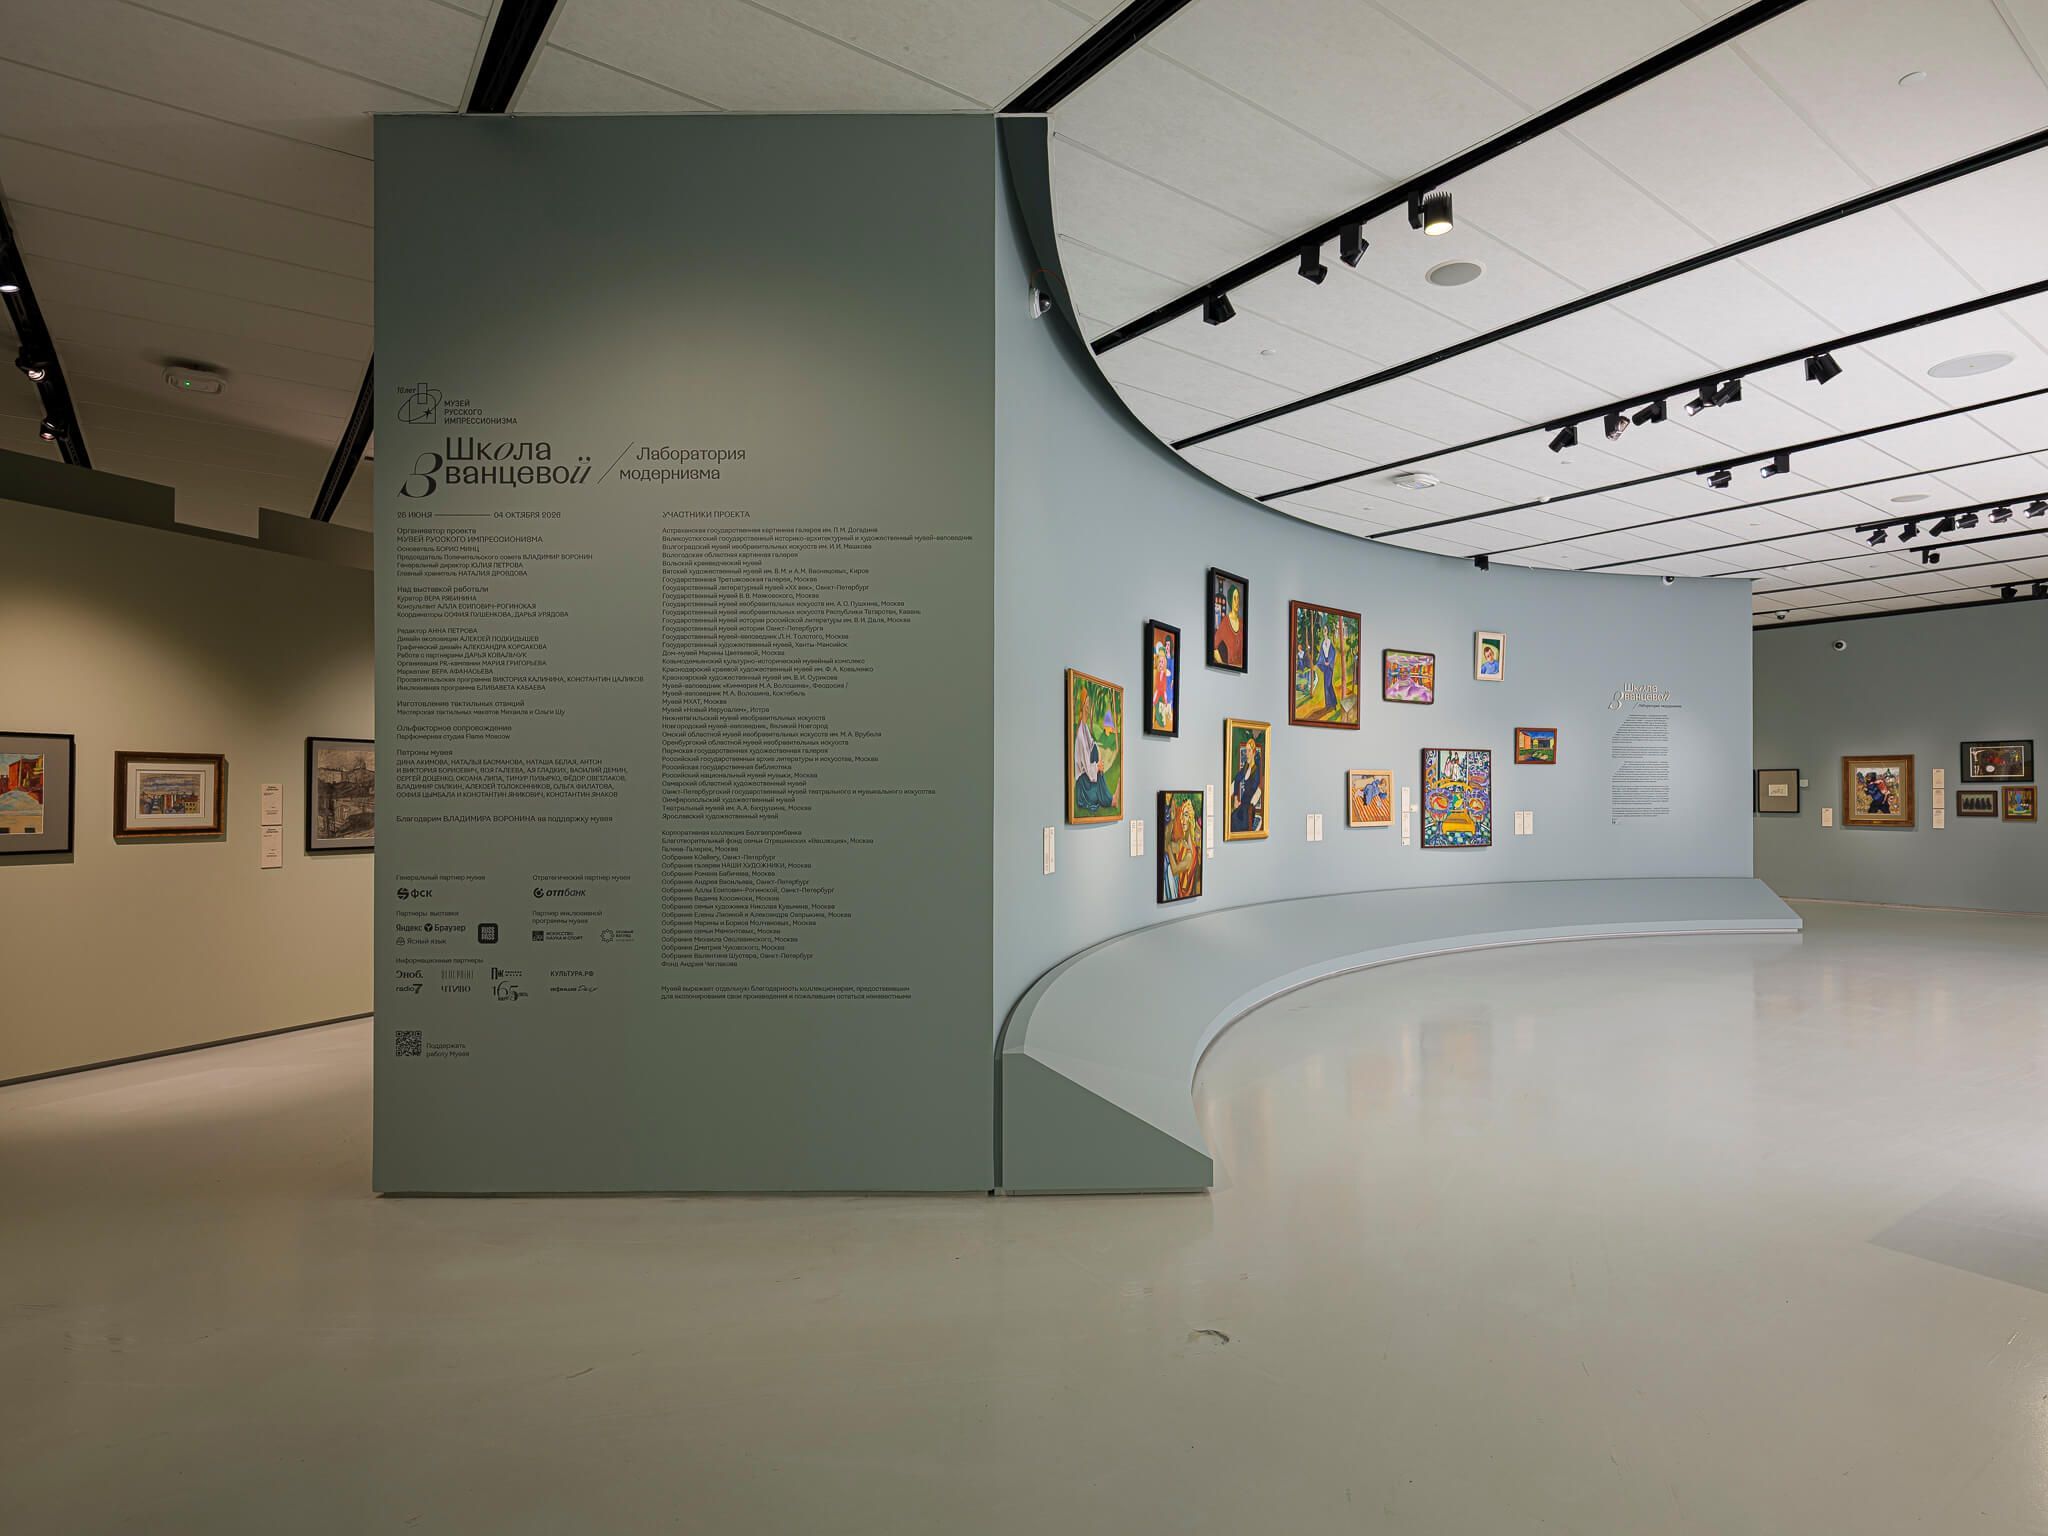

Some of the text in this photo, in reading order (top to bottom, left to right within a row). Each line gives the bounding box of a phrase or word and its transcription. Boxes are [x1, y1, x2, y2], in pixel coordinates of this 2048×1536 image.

[444, 399, 470, 407] МУЗЕЙ
[444, 408, 482, 416] РУССКОГО
[444, 417, 518, 425] ИМПРЕССИОНИЗМА
[446, 437, 551, 461] Школа
[636, 446, 746, 463] Лаборатория
[620, 467, 720, 483] модернизма
[409, 511, 432, 519] ИЮНЯ
[505, 511, 540, 519] ОКТЯБРЯ
[662, 510, 750, 519] УЧАСТНИКИ ПРОЕКТА
[397, 535, 543, 543] МУЗЕЙ РУССКОГО ИМПРЕССИОНИЗМА
[411, 889, 432, 898] ФСК
[396, 924, 466, 932] Яндекс Браузер
